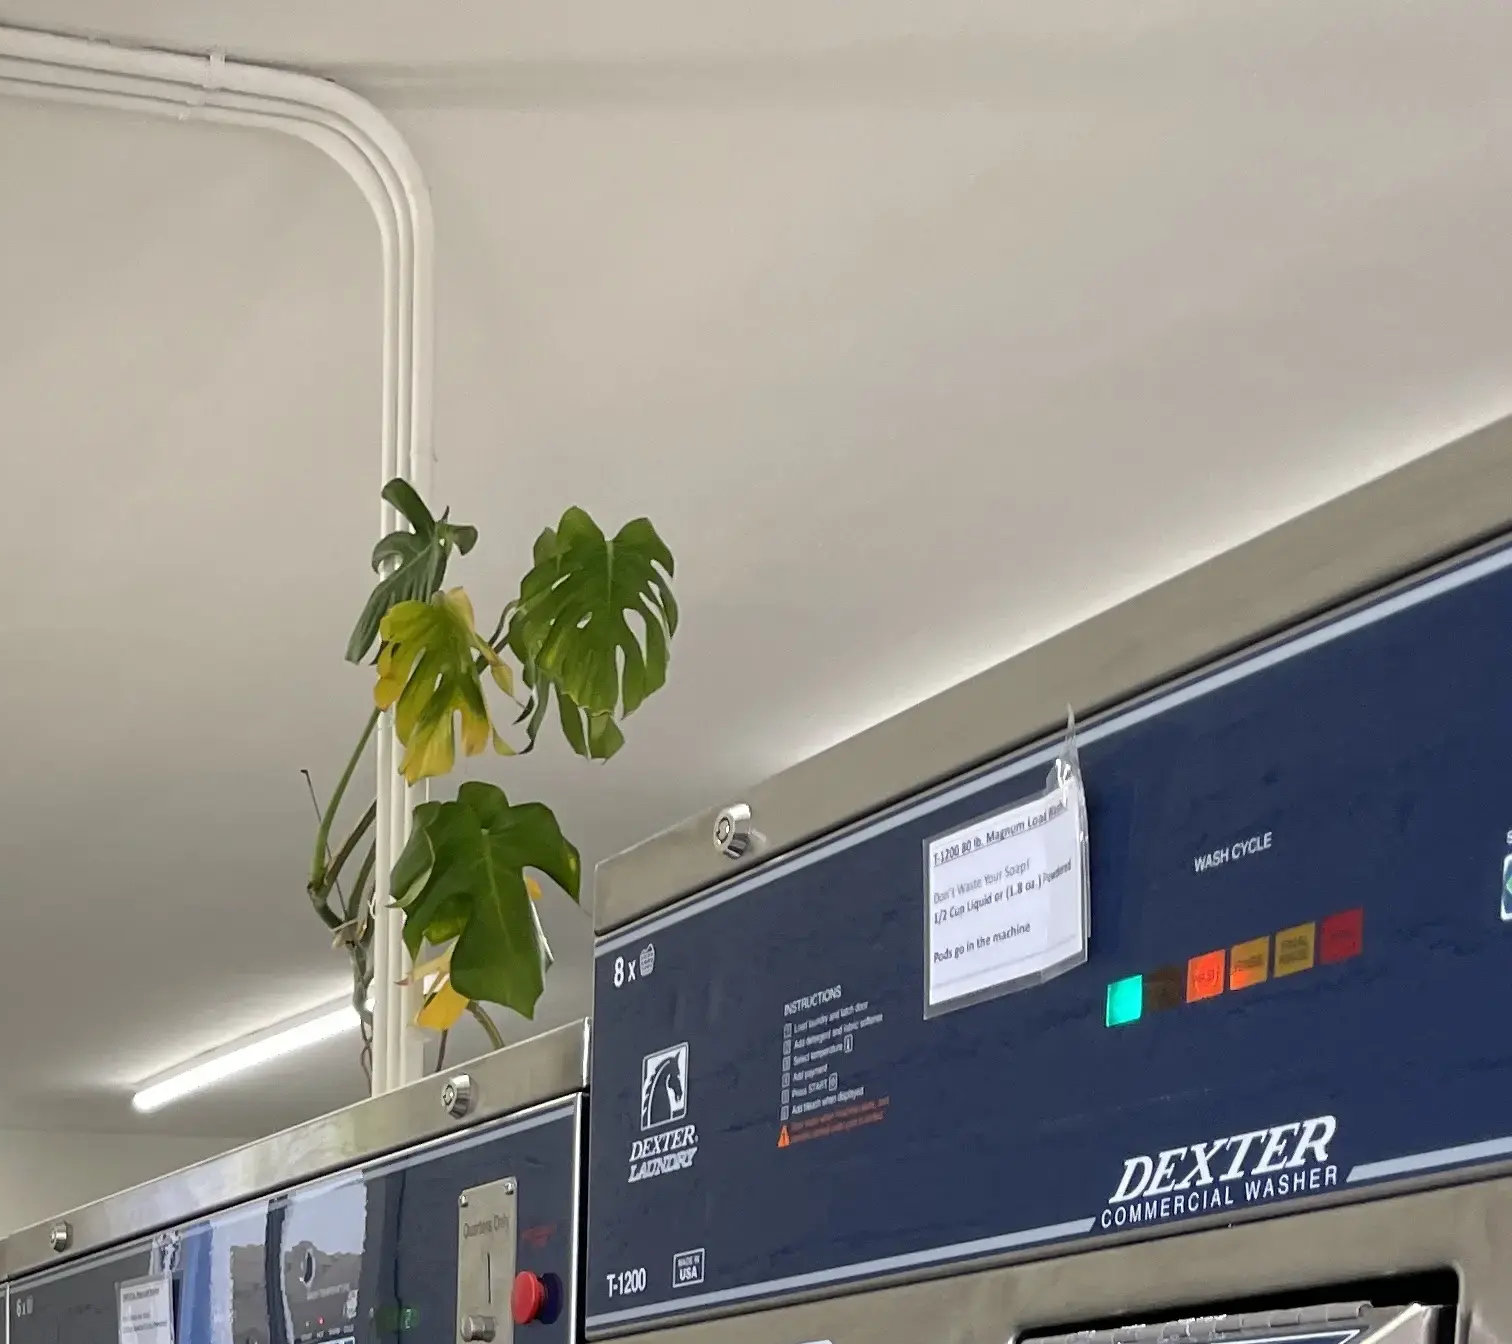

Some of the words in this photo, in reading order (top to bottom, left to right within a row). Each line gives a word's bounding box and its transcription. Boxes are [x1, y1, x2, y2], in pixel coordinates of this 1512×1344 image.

[933, 844, 960, 866] T-1200
[986, 820, 1025, 843] Magnum
[1194, 846, 1229, 873] WASH
[1231, 831, 1273, 860] CYCLE
[933, 887, 955, 904] Don't
[957, 878, 982, 894] Waste
[984, 868, 1003, 885] Your
[934, 909, 947, 925] 1/2
[967, 893, 993, 913] Liquid
[994, 890, 1004, 902] or
[1043, 858, 1072, 885] Powdered
[933, 946, 953, 963] Pods
[955, 944, 965, 959] go
[966, 939, 975, 951] in
[976, 933, 991, 947] the
[993, 922, 1031, 943] machine
[614, 956, 625, 988] 8
[628, 959, 637, 982] x
[783, 984, 842, 1017] INSTRUCTIONS
[628, 1124, 696, 1163] DEXTER
[1108, 1114, 1337, 1205] DEXTER
[627, 1146, 698, 1183] LAUNDRY
[1245, 1164, 1338, 1202] WASHER
[1101, 1186, 1234, 1229] COMMERCIAL
[606, 1267, 647, 1298] T-1200
[679, 1265, 698, 1282] USA
